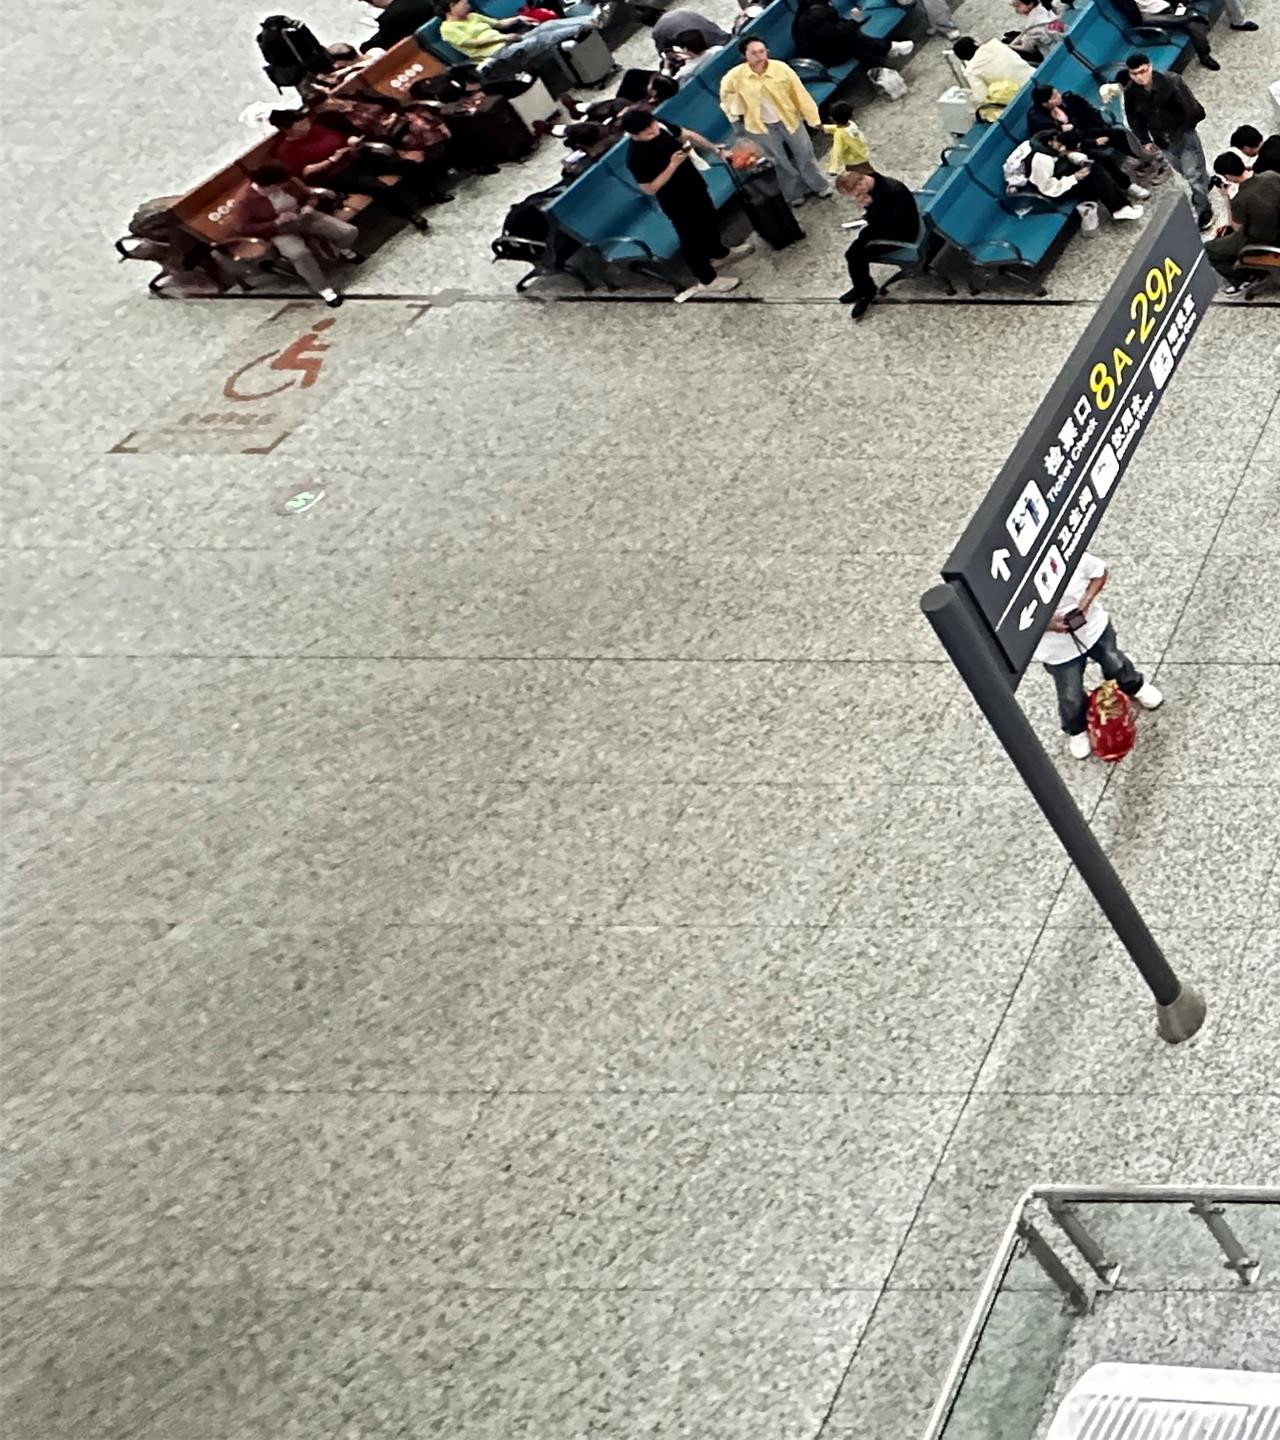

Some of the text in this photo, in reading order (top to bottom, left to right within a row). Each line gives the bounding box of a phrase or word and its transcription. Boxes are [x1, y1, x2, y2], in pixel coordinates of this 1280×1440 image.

[1089, 257, 1182, 410] 8A-29A
[1046, 417, 1098, 502] Ticket Check
[1057, 485, 1093, 551] 卫生间
